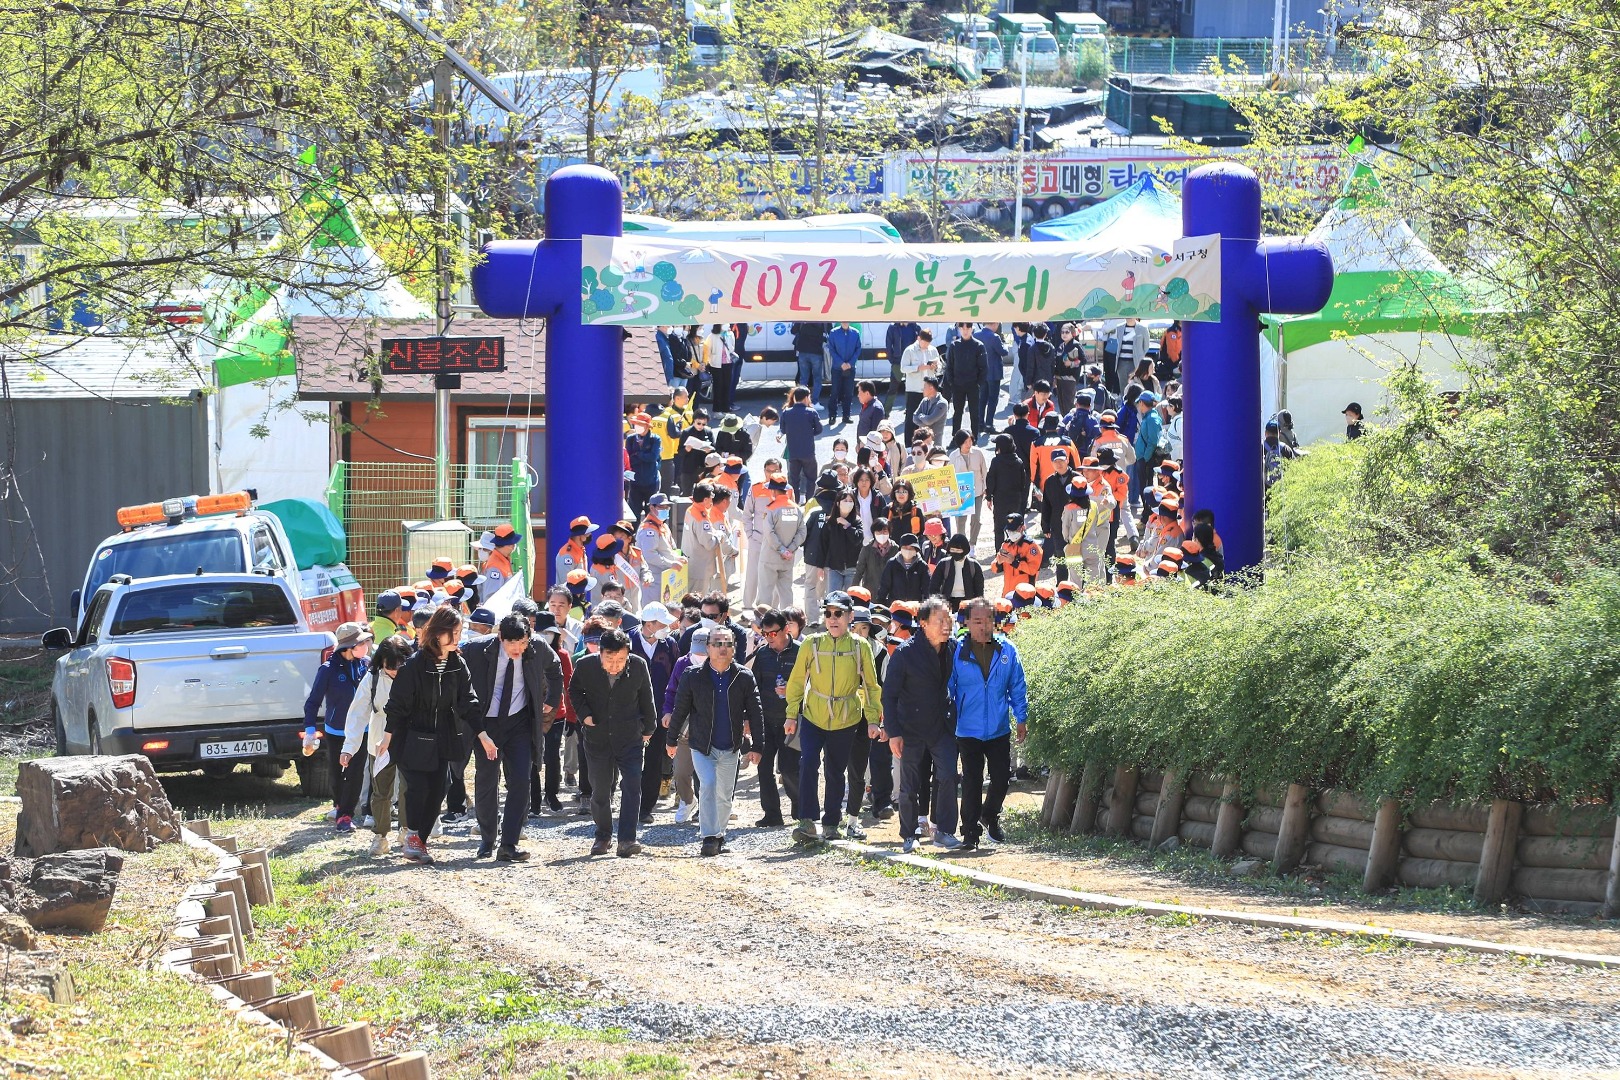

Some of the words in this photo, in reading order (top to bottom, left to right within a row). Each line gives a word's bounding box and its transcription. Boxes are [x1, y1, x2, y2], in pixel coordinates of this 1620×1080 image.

[1131, 255, 1148, 264] 주최
[1174, 248, 1208, 262] 서구청
[730, 258, 838, 314] 2023
[856, 257, 1050, 317] 와봄축제
[390, 339, 499, 370] 산불조심
[206, 743, 229, 755] 83노
[233, 741, 262, 753] 4470
